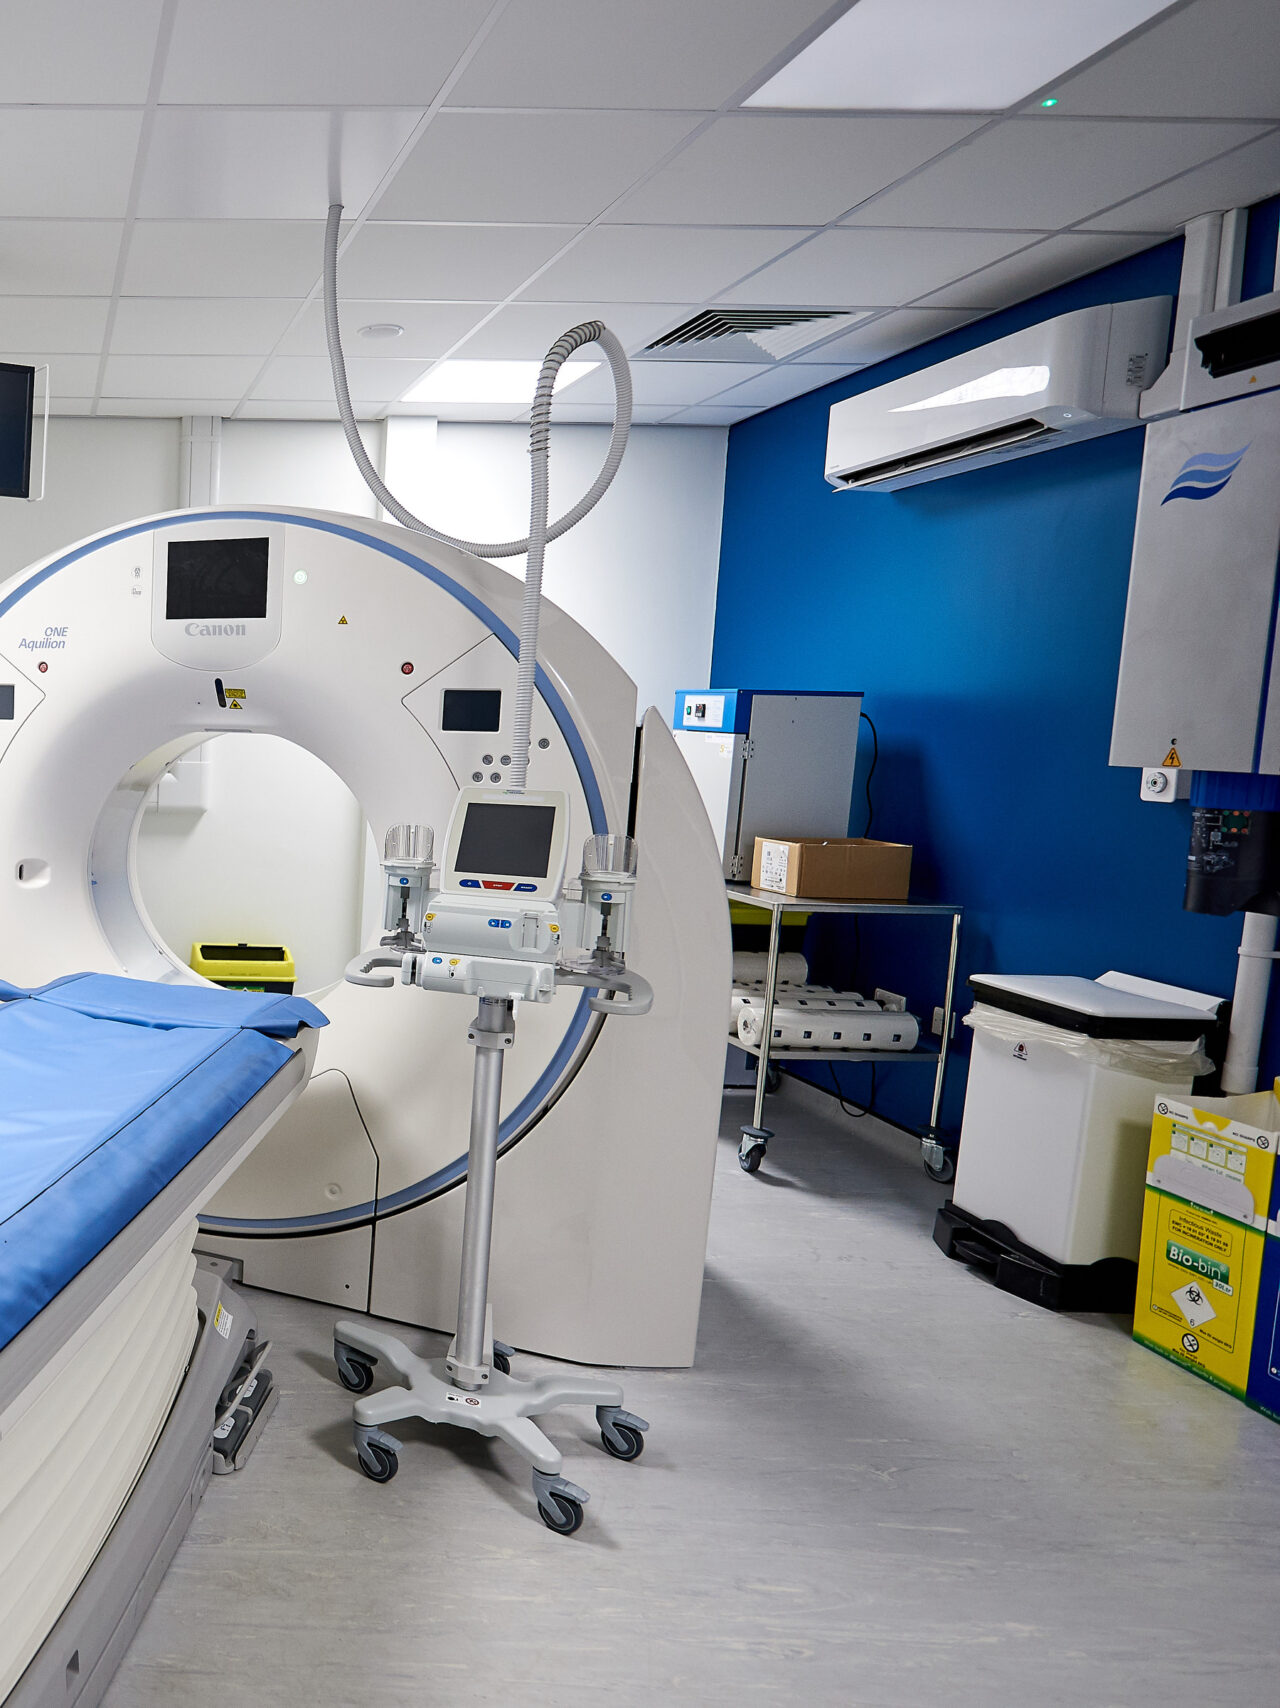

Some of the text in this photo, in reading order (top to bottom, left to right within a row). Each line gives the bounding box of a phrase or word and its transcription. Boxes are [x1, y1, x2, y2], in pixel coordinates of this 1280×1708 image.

[44, 626, 68, 636] ONE
[184, 622, 246, 636] Canon
[18, 638, 66, 652] Aquilion
[1179, 1216, 1204, 1230] Infectious
[1205, 1226, 1222, 1238] Waste
[1182, 1230, 1213, 1247] INCINERATION
[1214, 1243, 1226, 1252] ONLY
